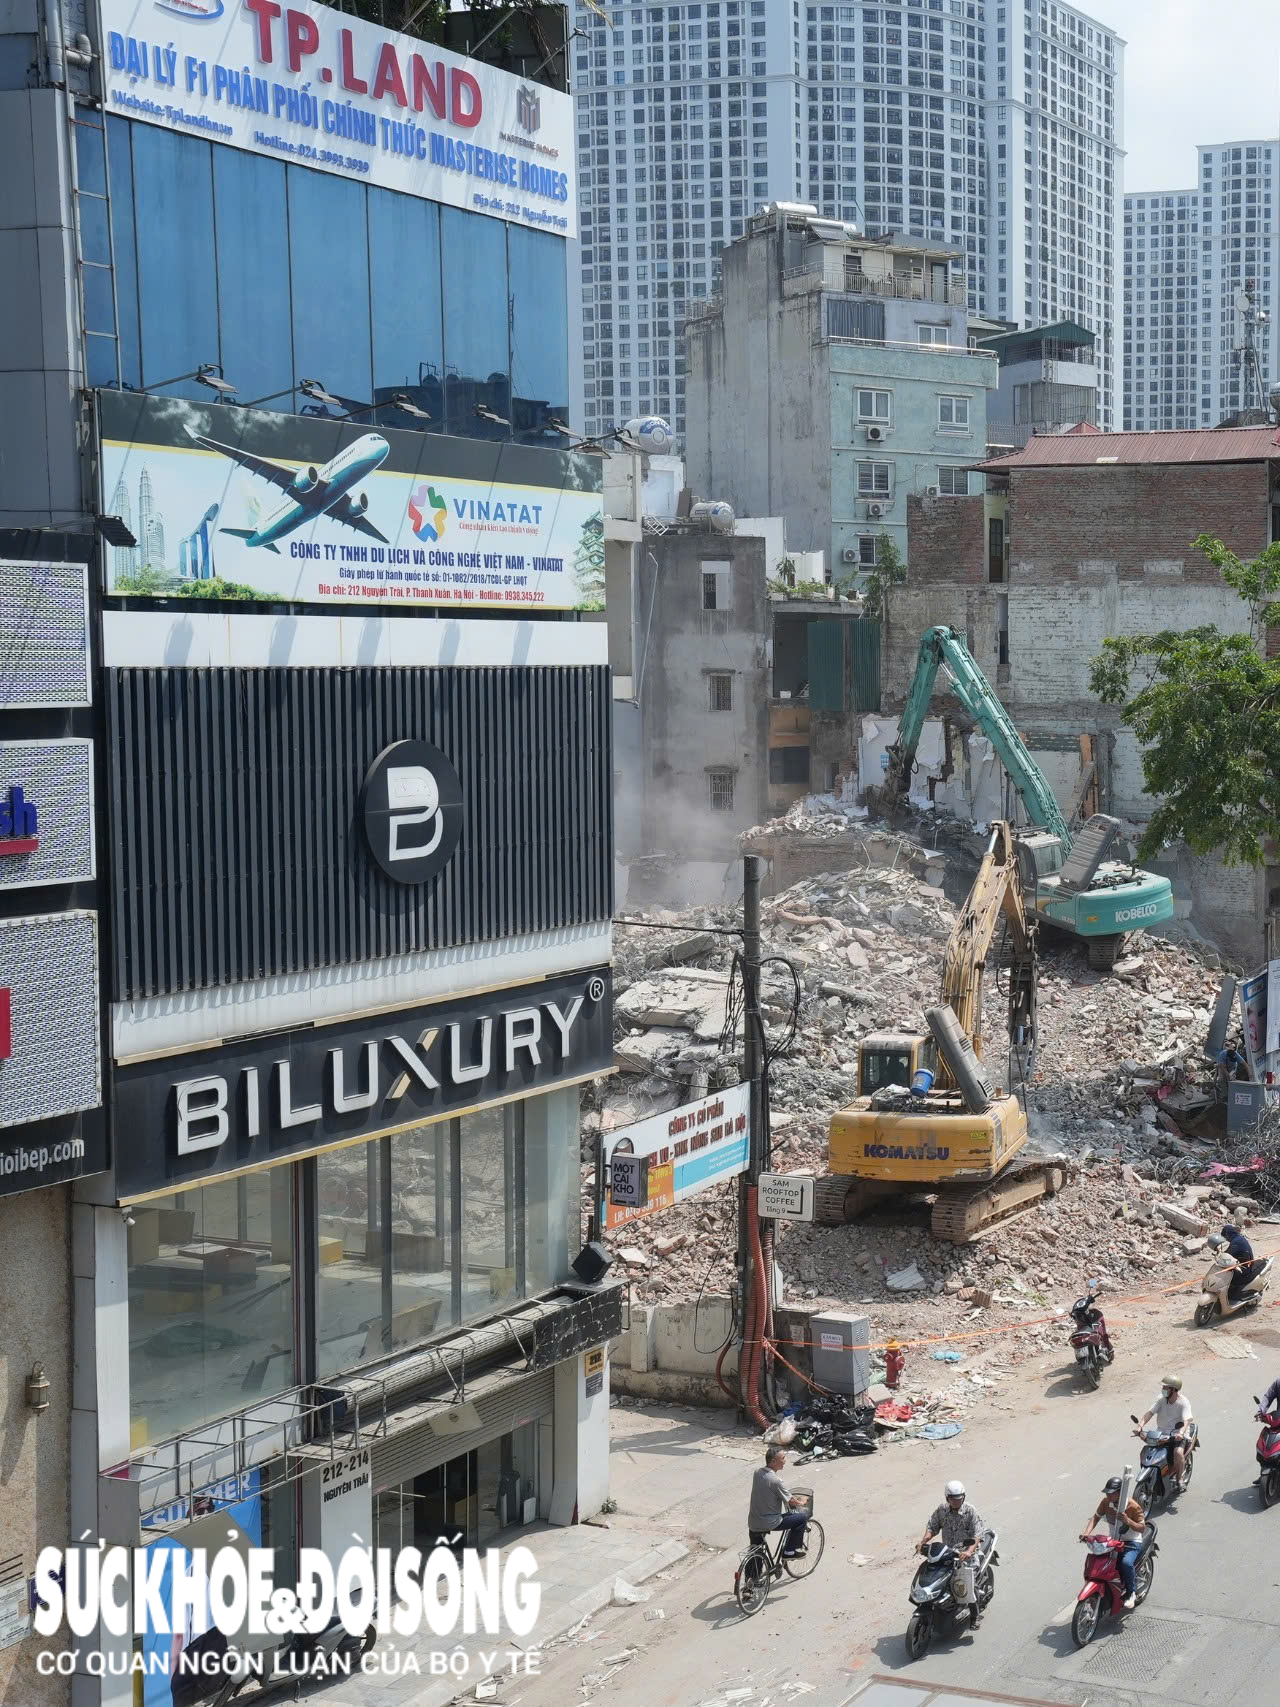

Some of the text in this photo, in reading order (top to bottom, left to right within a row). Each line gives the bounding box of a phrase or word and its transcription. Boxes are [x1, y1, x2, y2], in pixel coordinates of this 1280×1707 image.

[247, 0, 482, 128] TP.LAND
[108, 31, 568, 201] ĐẠI LÝ F1 PHÂN PHỐI CHÍNH THỨC MASTERISE HOMES
[453, 498, 542, 525] VINATAT
[290, 540, 320, 559] CÔNG
[323, 544, 336, 560] TY
[340, 545, 367, 562] TNHH
[371, 547, 384, 563] DU
[388, 548, 410, 567] LỊCH
[413, 548, 426, 565] VÀ
[428, 548, 454, 567] CÔNG
[457, 551, 481, 571] NGHỆ
[484, 552, 502, 571] VIỆT
[505, 555, 524, 570] NAM
[532, 556, 563, 572] VINATAT
[347, 584, 360, 596] 212
[412, 587, 433, 598] Thanh
[1115, 904, 1157, 923] KOBELCO
[172, 995, 585, 1156] BILUXURY
[863, 1143, 950, 1161] KOMATSU
[613, 1161, 635, 1174] MỘT
[613, 1183, 634, 1194] KHO
[762, 1186, 799, 1197] ROOFTOP
[772, 1179, 790, 1188] SAM
[765, 1196, 795, 1206] COFFEE
[323, 1450, 369, 1483] 212-214
